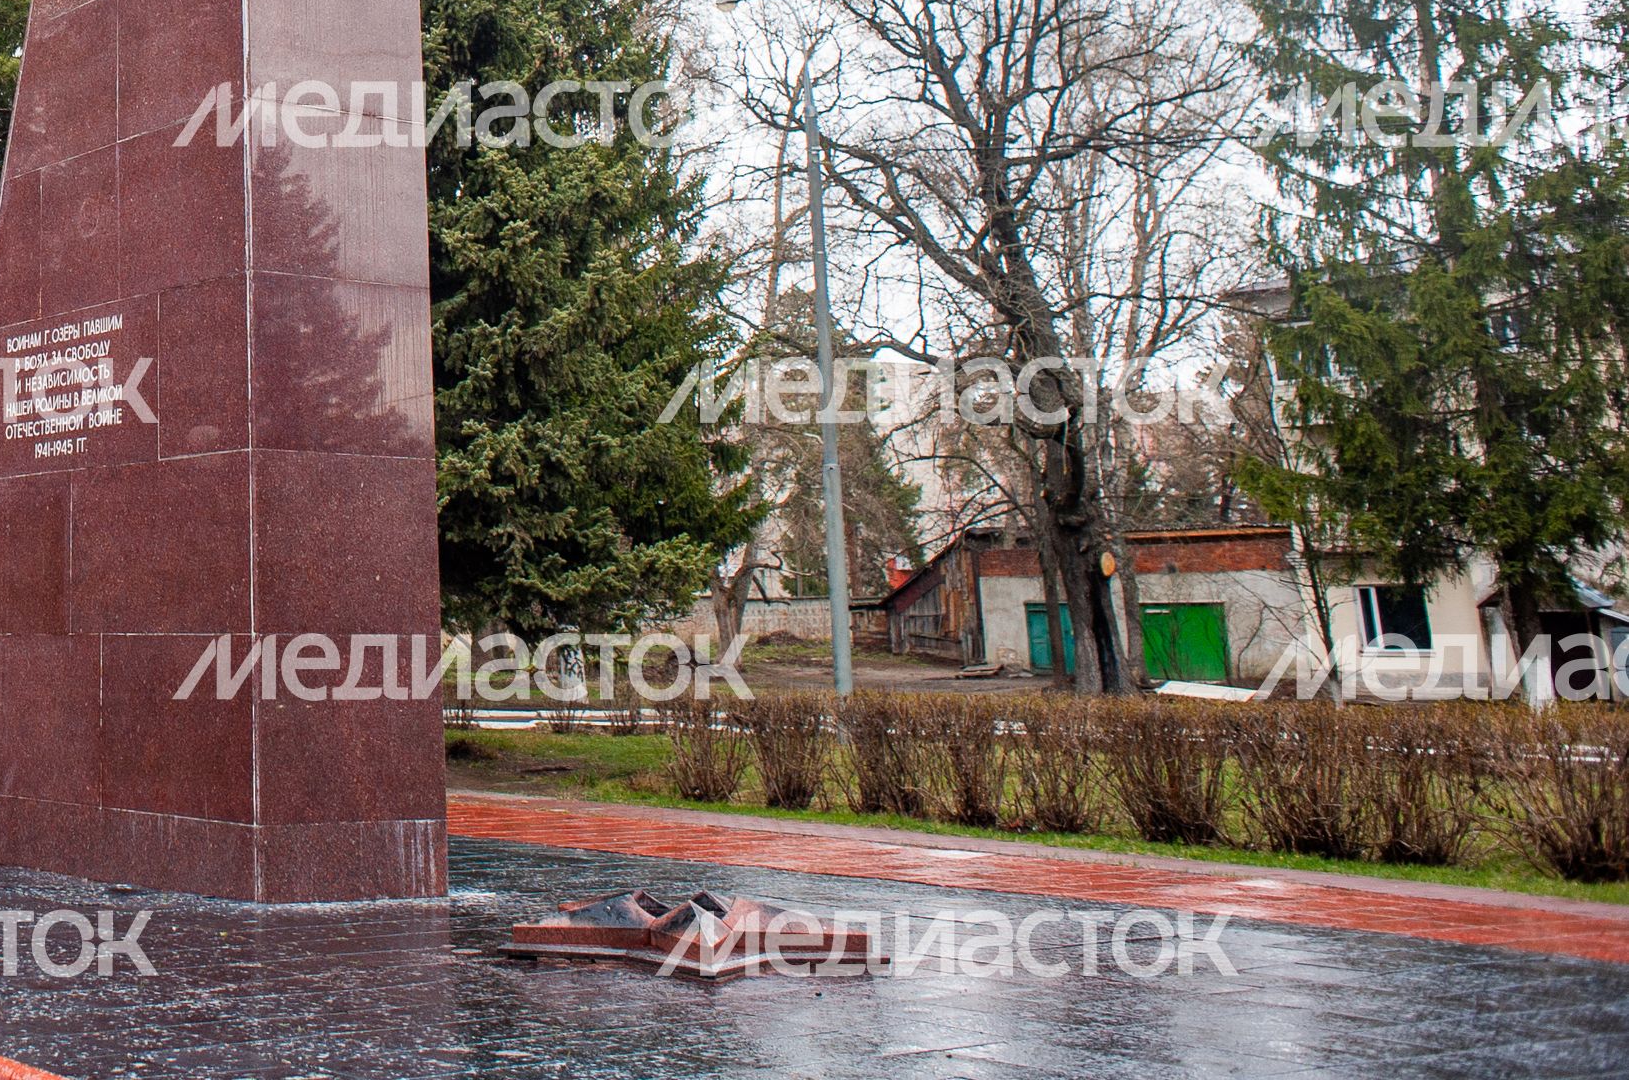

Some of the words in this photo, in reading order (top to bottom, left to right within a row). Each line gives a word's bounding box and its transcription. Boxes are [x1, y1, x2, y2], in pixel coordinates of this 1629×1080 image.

[7, 331, 41, 353] ВОИНАМ
[83, 314, 123, 337] ПАВШИМ
[14, 358, 21, 373] В
[24, 352, 49, 372] БОЯХ
[51, 350, 62, 366] ЗА
[65, 340, 111, 363] СВОБОДУ
[14, 379, 22, 395] И
[25, 364, 110, 392] НЕЗАВИСИМОСТЬ
[35, 392, 71, 412] РОДИНЫ
[73, 391, 80, 407] В
[5, 414, 84, 440] ОТЕЧЕСТВЕННОЙ
[88, 408, 123, 430] ВОЙНЕ
